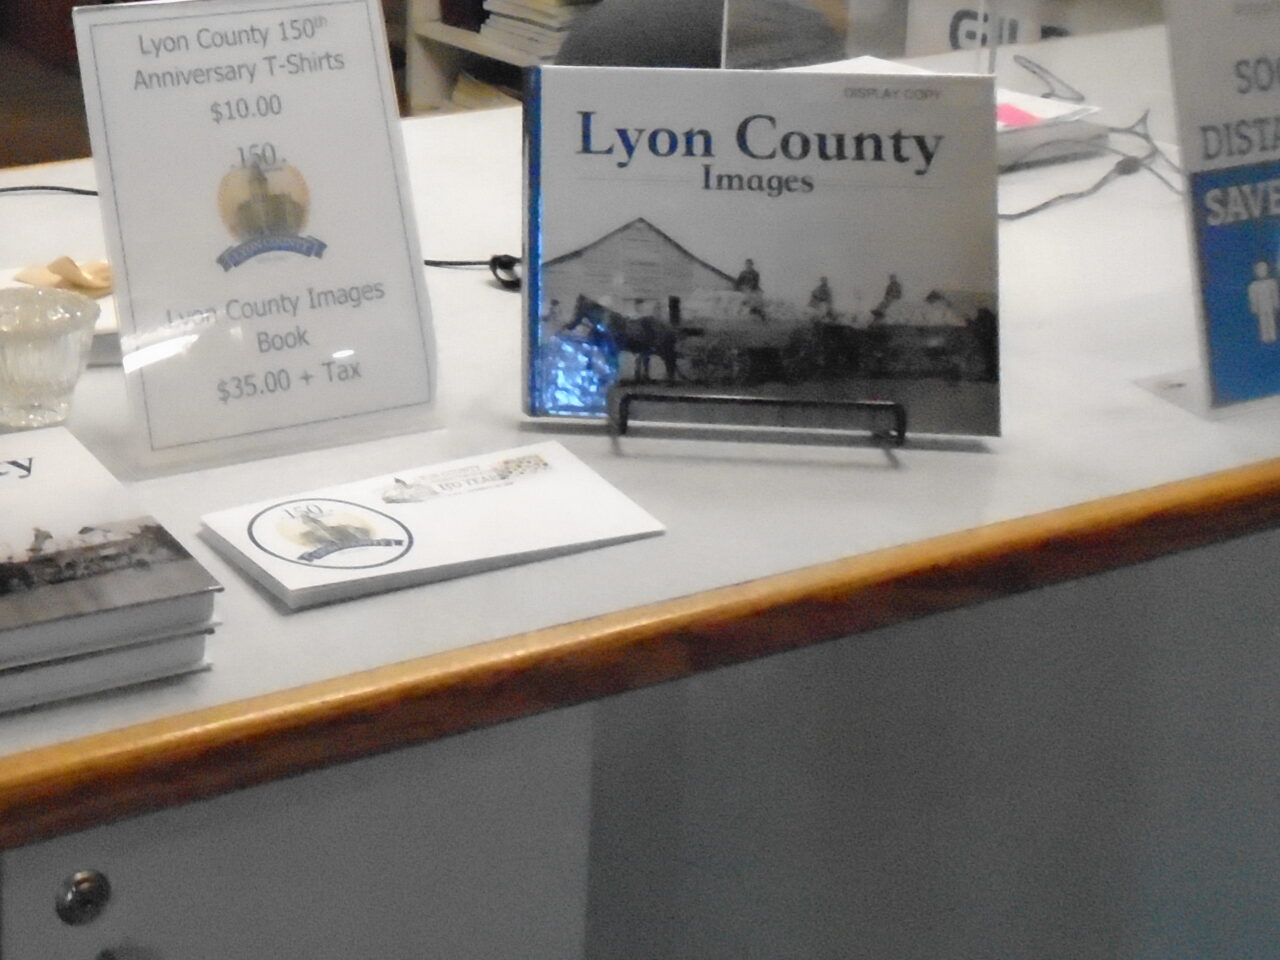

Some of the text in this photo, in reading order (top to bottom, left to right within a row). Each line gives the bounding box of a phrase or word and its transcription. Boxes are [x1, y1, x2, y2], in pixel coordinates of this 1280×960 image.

[138, 33, 190, 59] Lyon
[196, 24, 269, 49] County
[134, 50, 346, 91] Anniversary T-Shirts
[210, 93, 283, 125] $10.00
[237, 142, 277, 169] 150
[576, 111, 946, 176] Lyon County
[700, 163, 816, 198] Images
[225, 292, 300, 321] County
[306, 281, 386, 309] Images
[257, 325, 311, 354] Book
[217, 358, 362, 404] $35.00 + Tax
